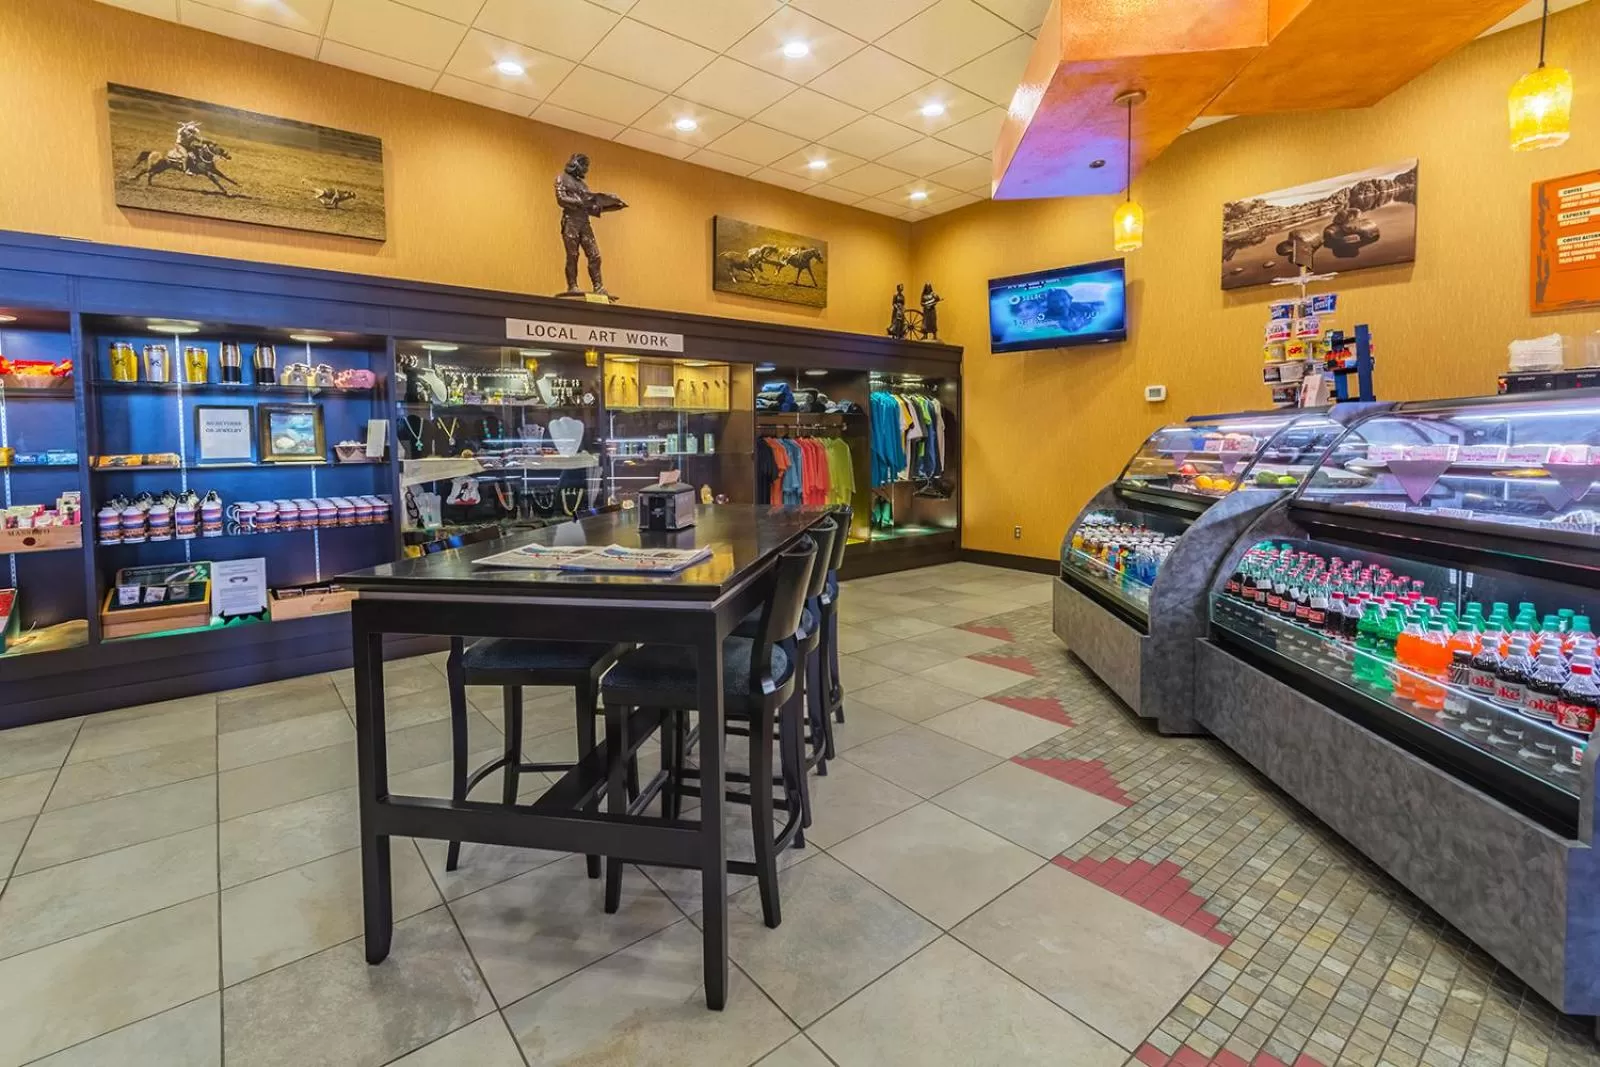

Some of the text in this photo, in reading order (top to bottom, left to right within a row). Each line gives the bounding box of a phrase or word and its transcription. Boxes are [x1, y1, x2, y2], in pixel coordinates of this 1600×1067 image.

[526, 323, 669, 347] LOCAL ART WORK
